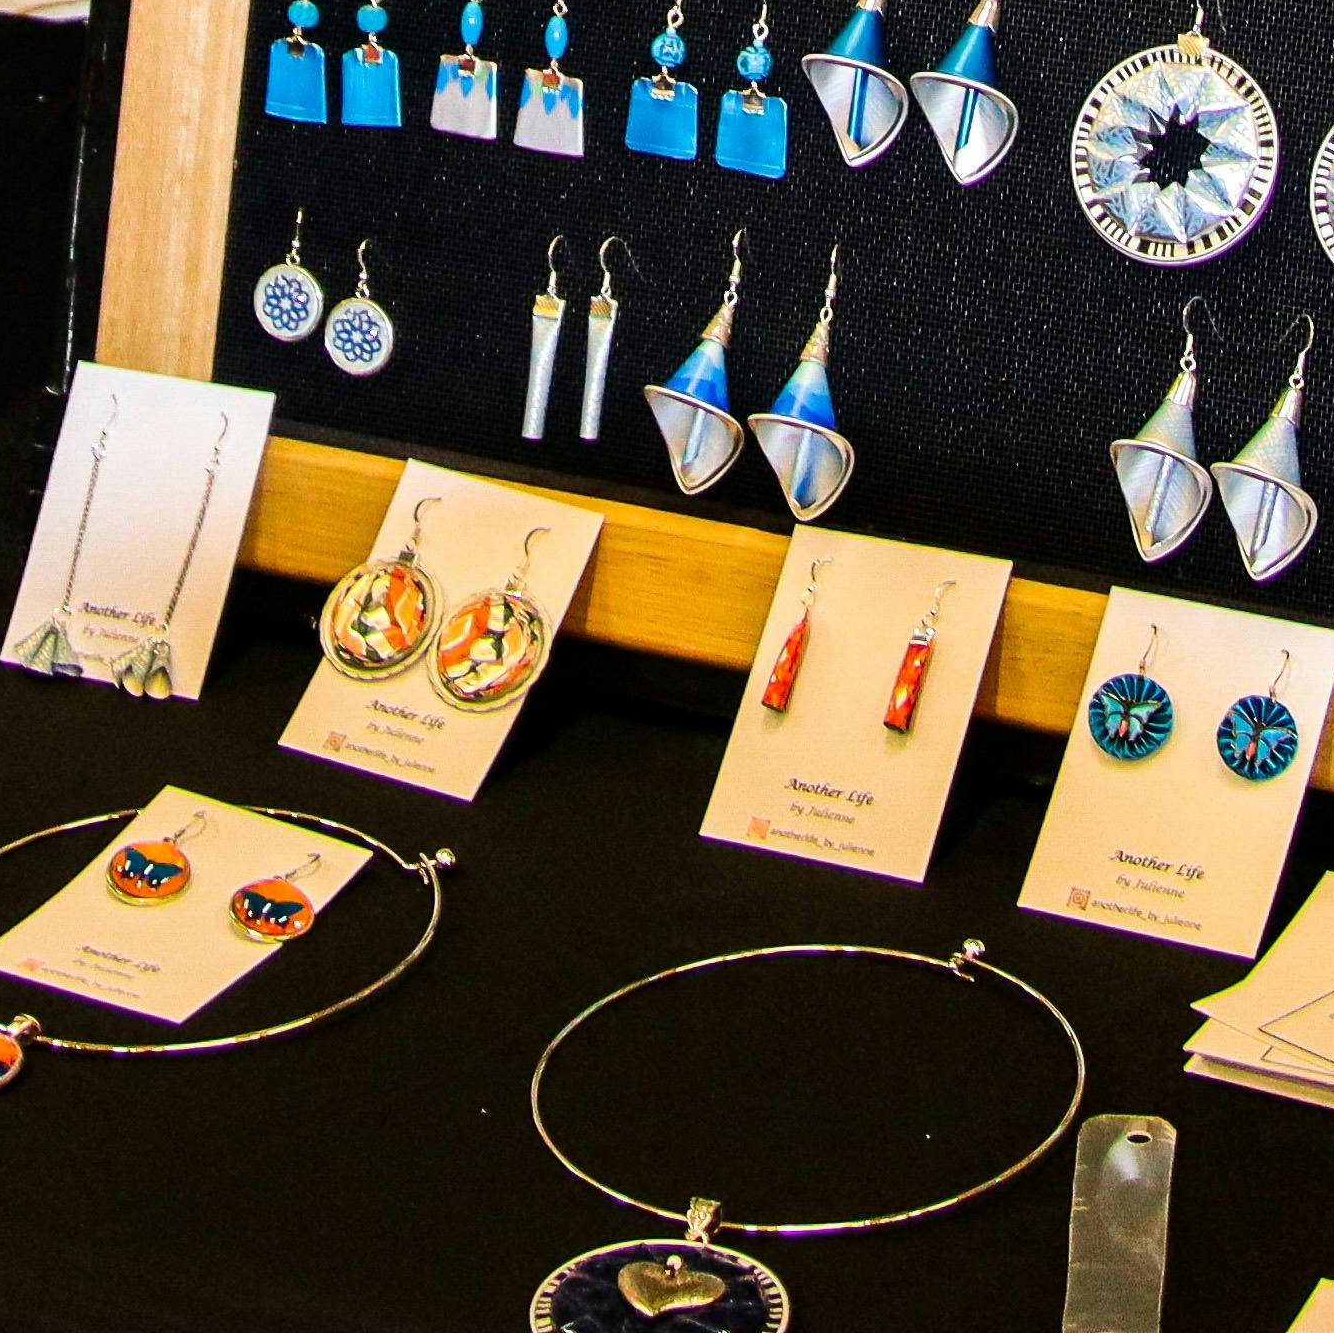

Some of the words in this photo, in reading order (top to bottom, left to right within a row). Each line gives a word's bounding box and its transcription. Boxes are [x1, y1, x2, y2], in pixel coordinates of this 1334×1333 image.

[784, 777, 845, 798] Another
[846, 789, 875, 808] Life
[1109, 849, 1174, 872] Another
[1175, 863, 1205, 882] Life
